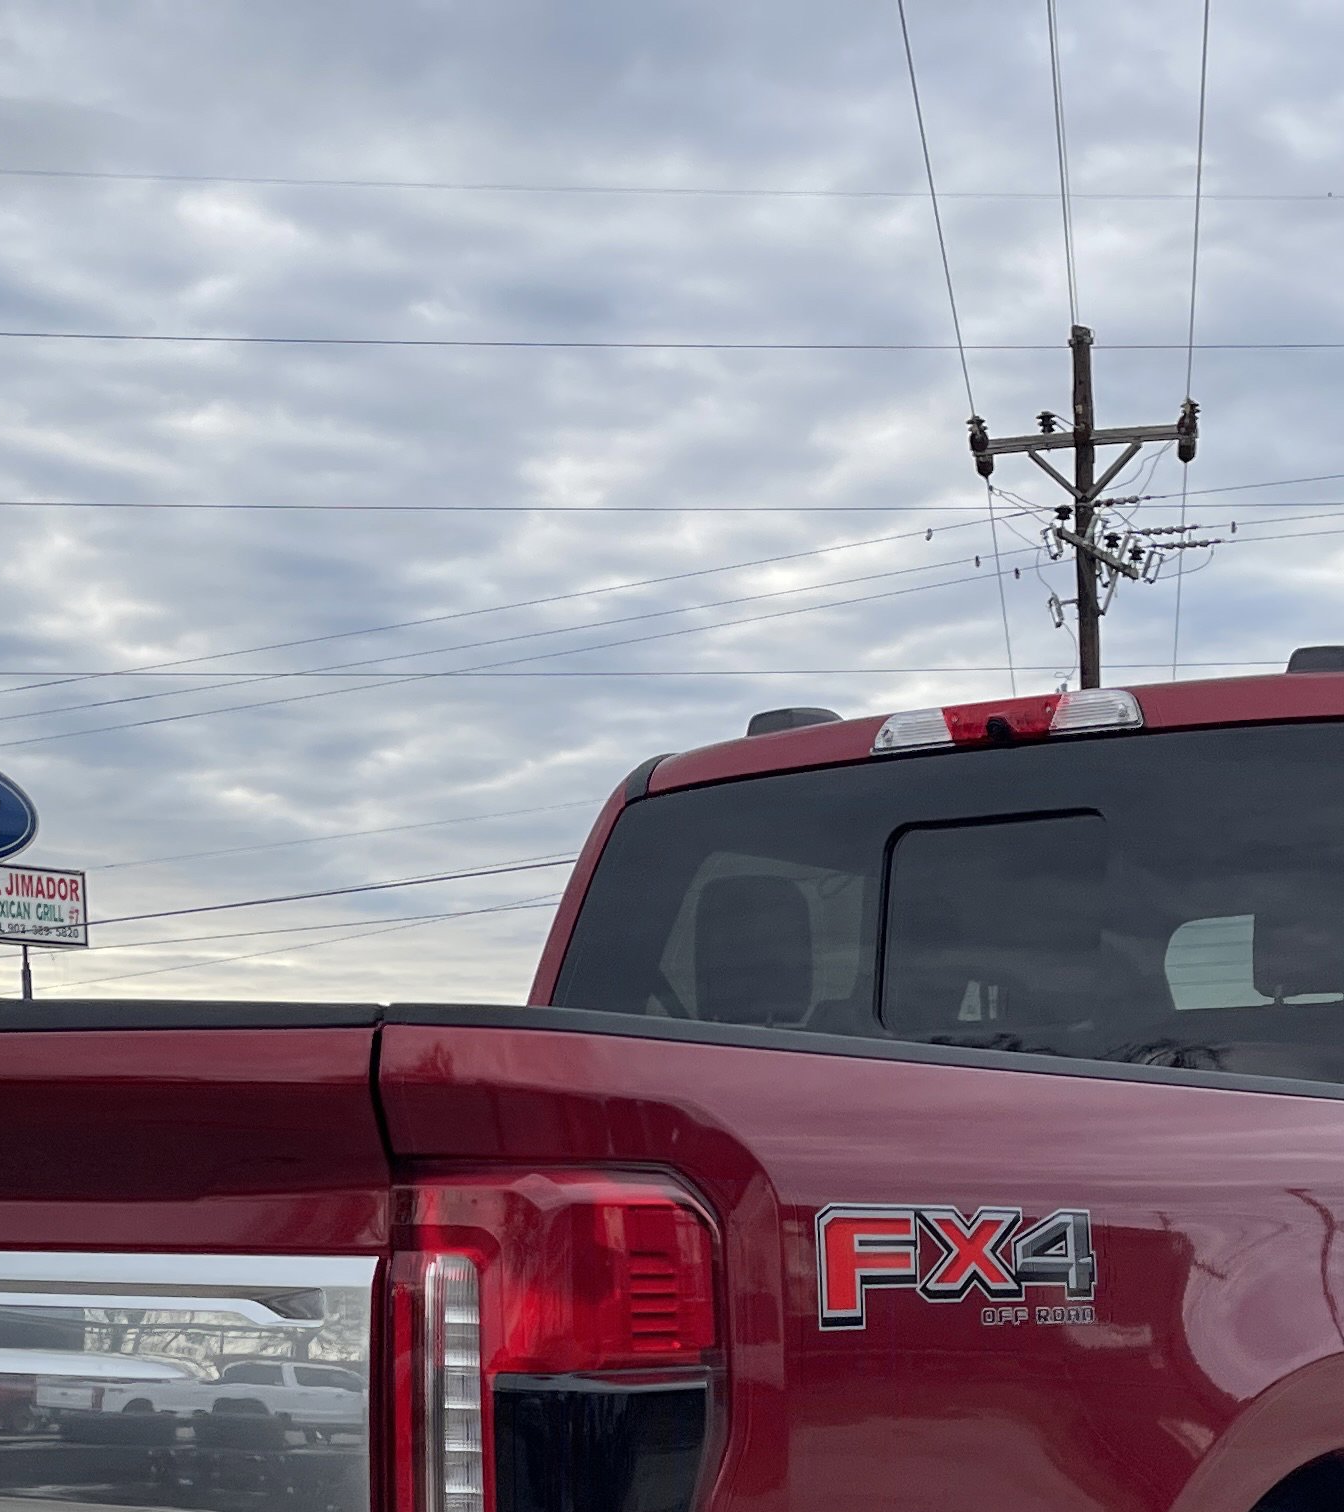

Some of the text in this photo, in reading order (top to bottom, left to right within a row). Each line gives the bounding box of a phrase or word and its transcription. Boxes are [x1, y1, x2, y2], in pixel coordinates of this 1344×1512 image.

[5, 873, 80, 902] JIMADOR
[35, 901, 65, 923] GRILL
[815, 1202, 1098, 1332] FX4
[981, 1305, 1096, 1326] OFF ROAD
